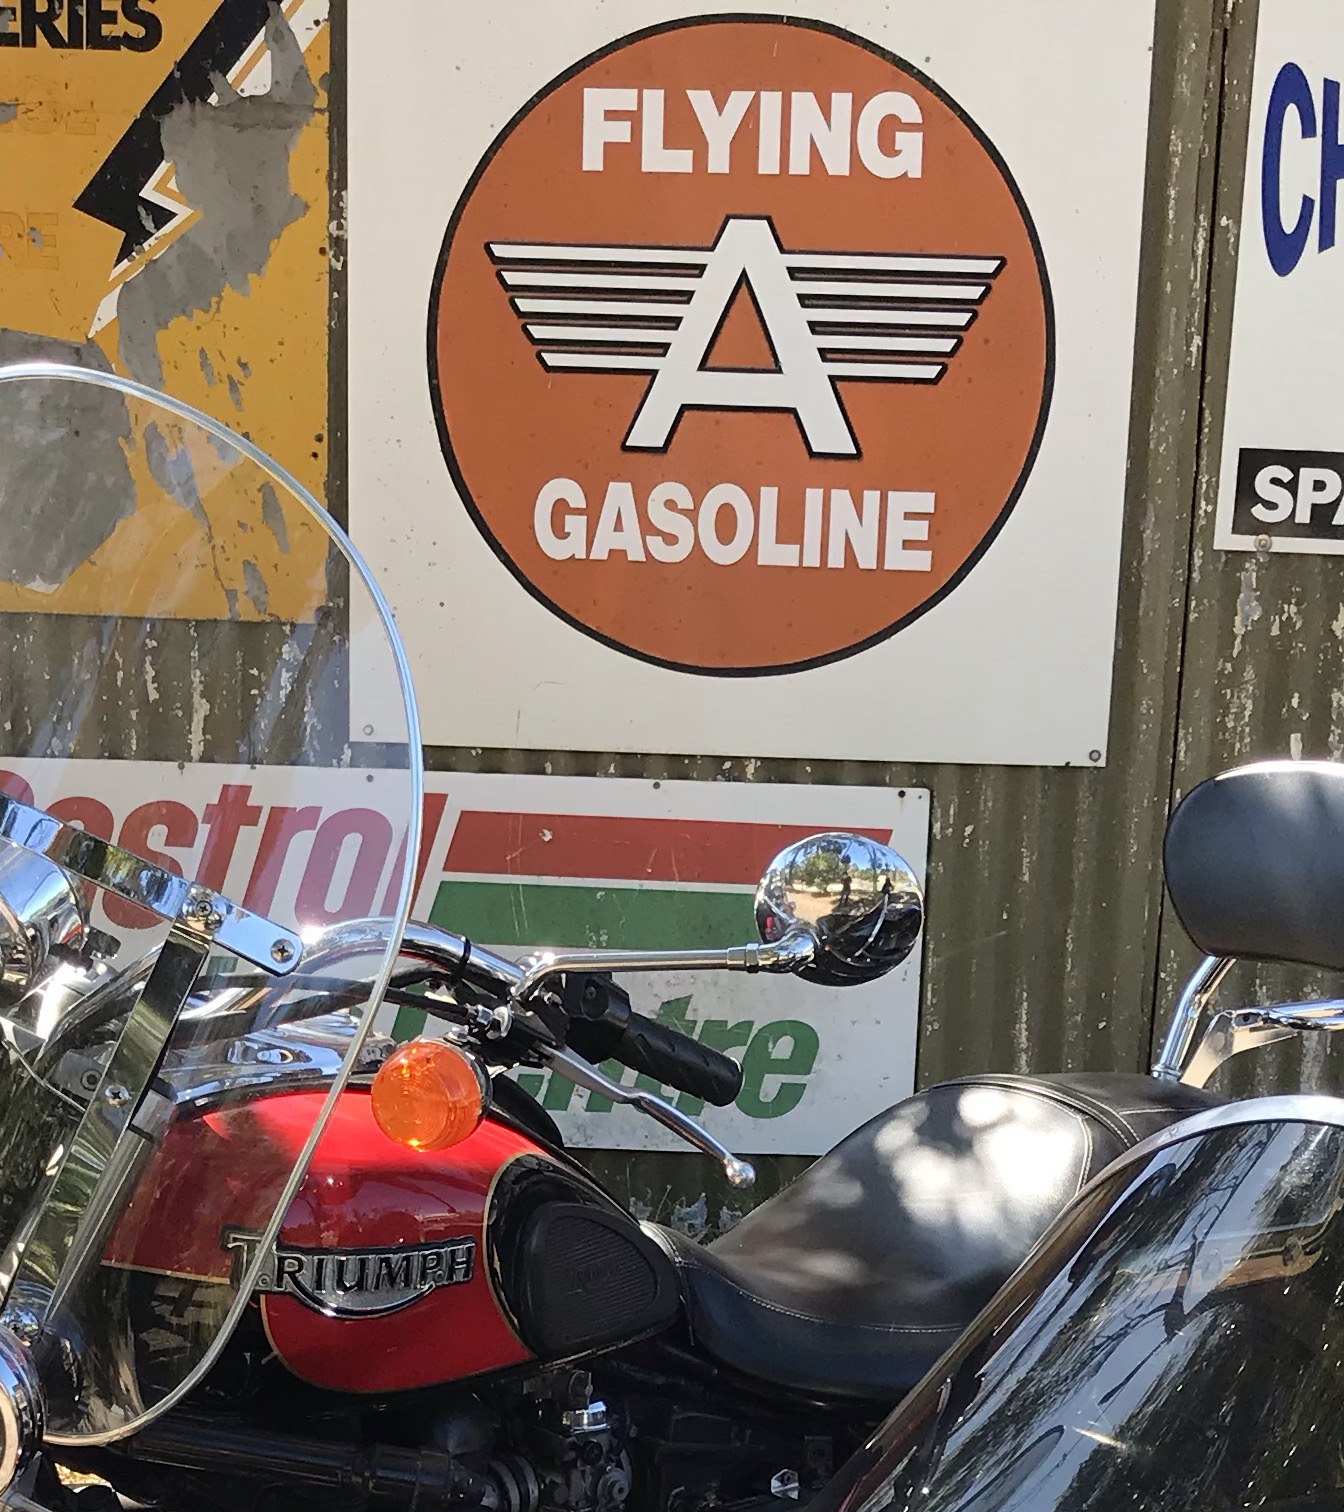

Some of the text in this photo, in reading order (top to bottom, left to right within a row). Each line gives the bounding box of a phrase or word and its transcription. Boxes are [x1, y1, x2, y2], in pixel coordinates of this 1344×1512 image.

[581, 87, 925, 180] FLYING
[621, 213, 862, 461] A
[533, 477, 937, 572] GASOLINE
[222, 1230, 476, 1296] TRIUMPH
